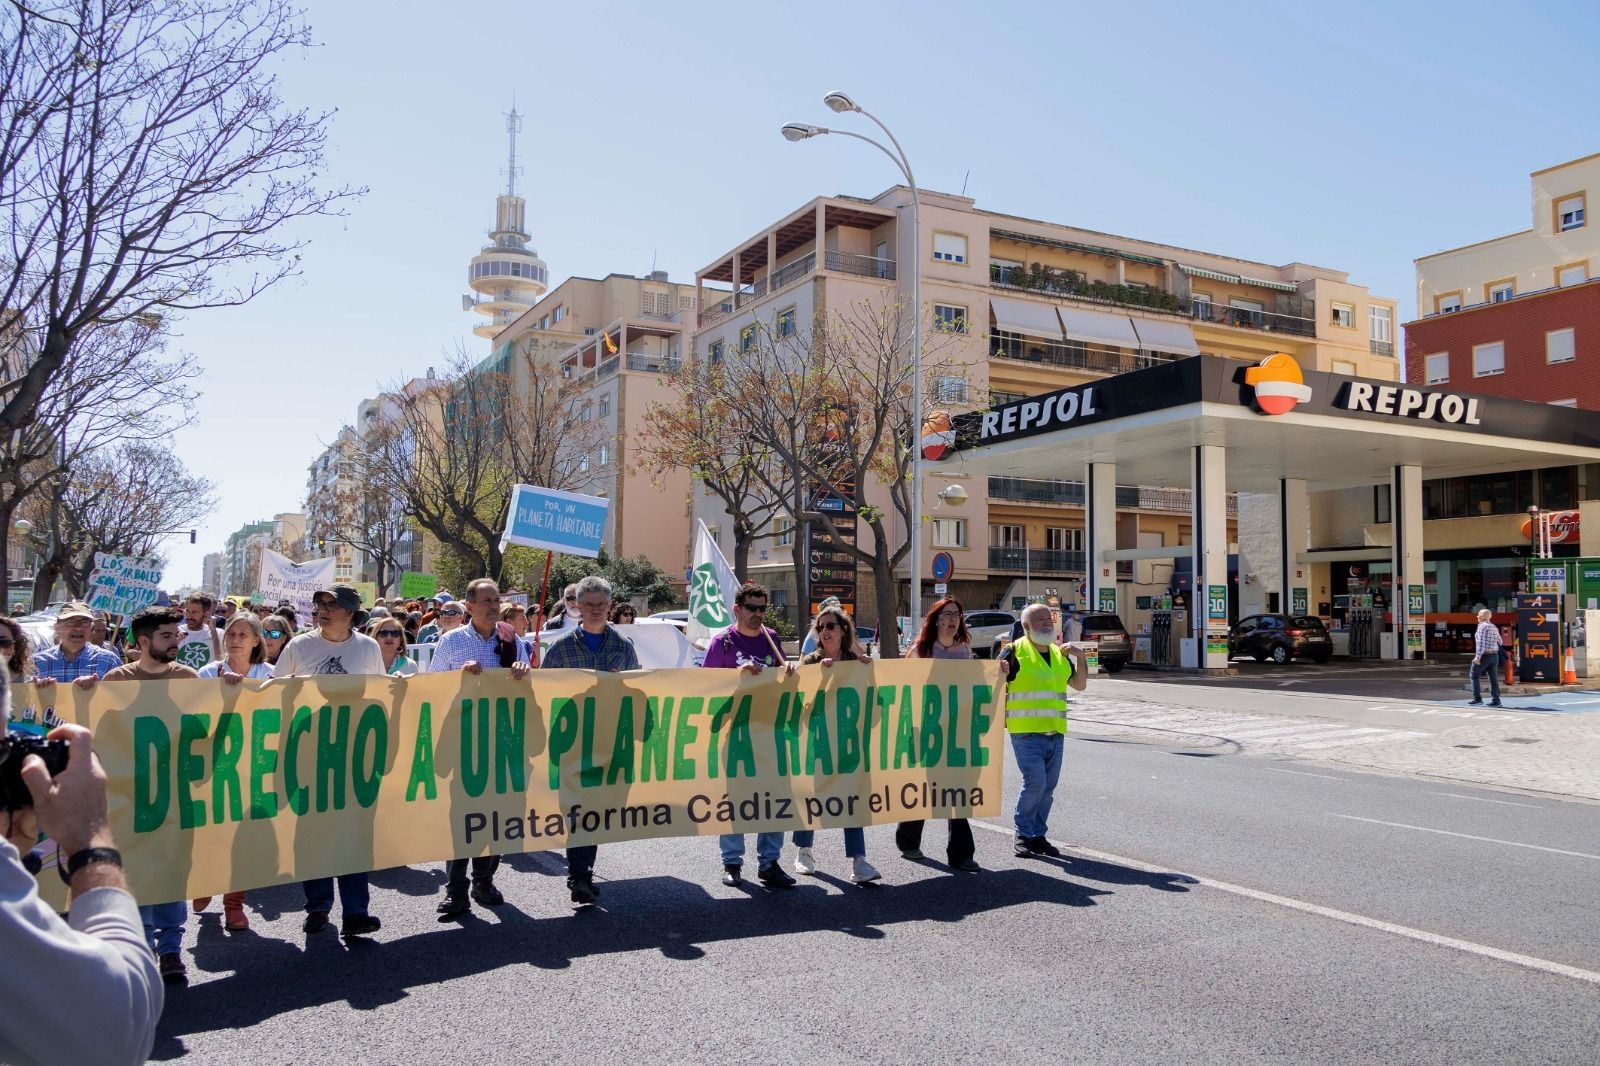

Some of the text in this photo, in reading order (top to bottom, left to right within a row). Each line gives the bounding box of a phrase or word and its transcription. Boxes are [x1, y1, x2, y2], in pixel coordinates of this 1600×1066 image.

[981, 387, 1096, 439] REPSOL
[1348, 381, 1480, 425] REPSOL
[544, 500, 576, 513] POR UN
[518, 507, 602, 538] PLANETA HABITABLE
[101, 557, 124, 571] LOS
[95, 575, 117, 587] SON
[120, 568, 161, 585] ARBOLES
[268, 574, 281, 587] Por
[283, 579, 297, 590] una
[133, 684, 993, 834] DERECHO A UN PLANETA HABITABLE
[464, 782, 985, 844] Plataforma Cádiz por el Clima
